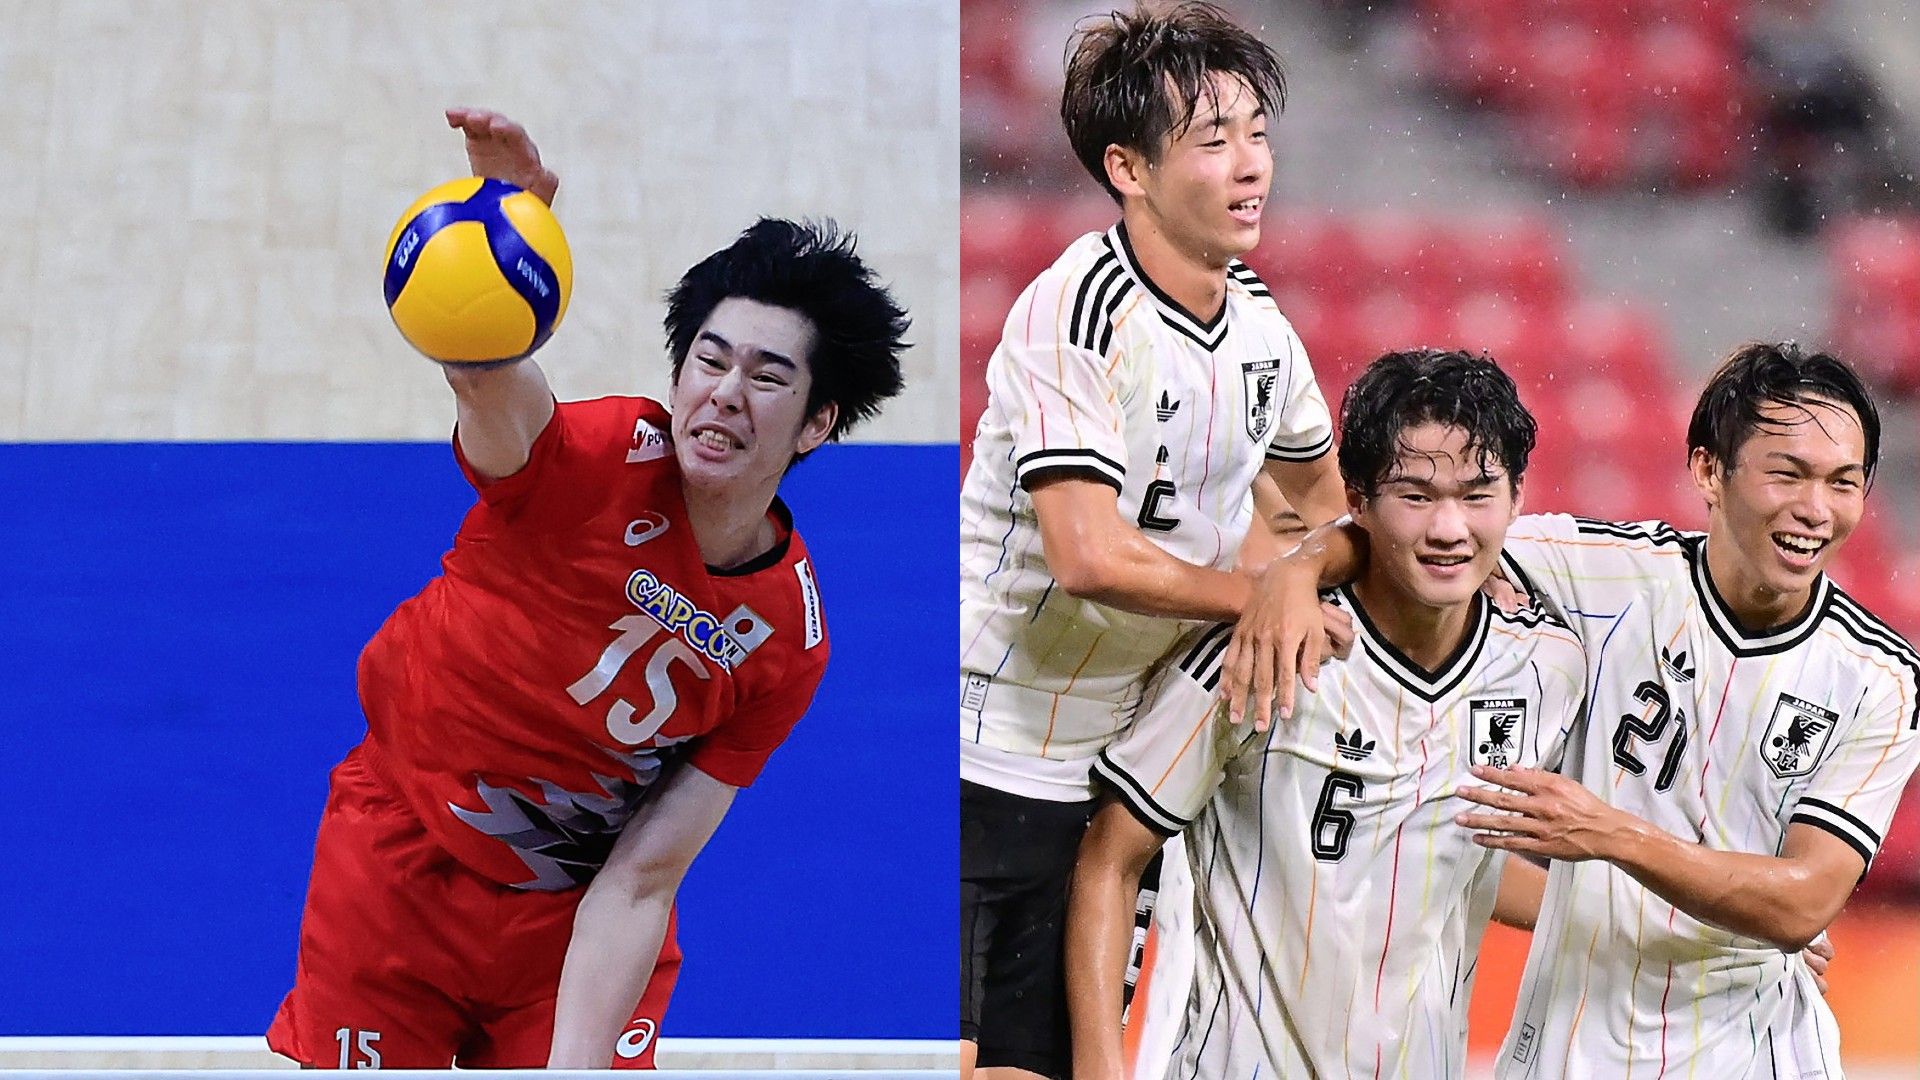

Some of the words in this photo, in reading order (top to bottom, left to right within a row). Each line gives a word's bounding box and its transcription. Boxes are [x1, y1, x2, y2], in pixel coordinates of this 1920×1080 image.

[1251, 361, 1274, 371] JAPAN
[807, 584, 819, 640] POWER
[566, 615, 711, 746] 15
[1482, 700, 1515, 709] JAPAN
[1792, 698, 1826, 717] JAPAN
[1612, 680, 1688, 795] 21
[1772, 750, 1799, 770] JFA
[1311, 770, 1367, 864] 6
[336, 1027, 381, 1070] 15
